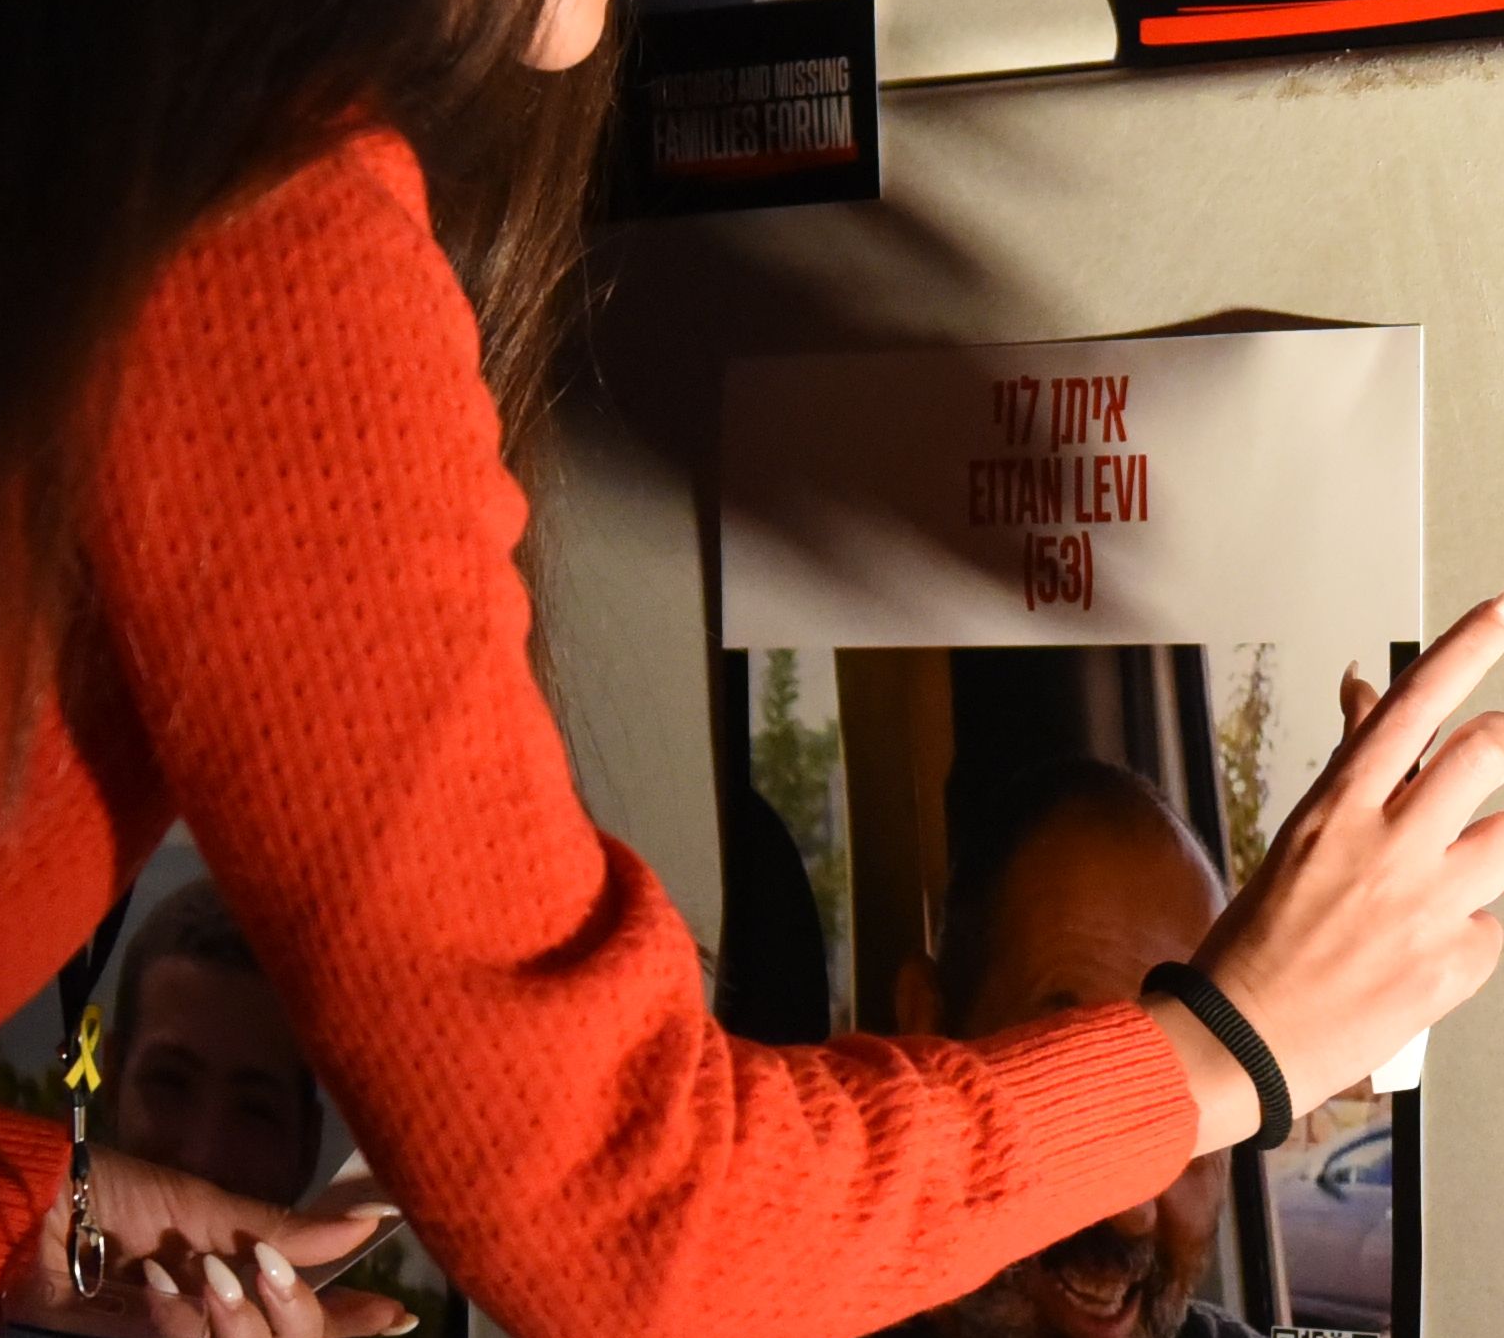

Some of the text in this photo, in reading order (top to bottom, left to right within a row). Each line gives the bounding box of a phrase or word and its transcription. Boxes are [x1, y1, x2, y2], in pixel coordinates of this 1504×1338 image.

[773, 55, 852, 99] MISSING
[653, 93, 854, 165] FAMILIES FORUM
[993, 375, 1129, 452] איתן לוי
[968, 454, 1148, 527] EITAN LEVI
[1024, 531, 1093, 611] (53)
